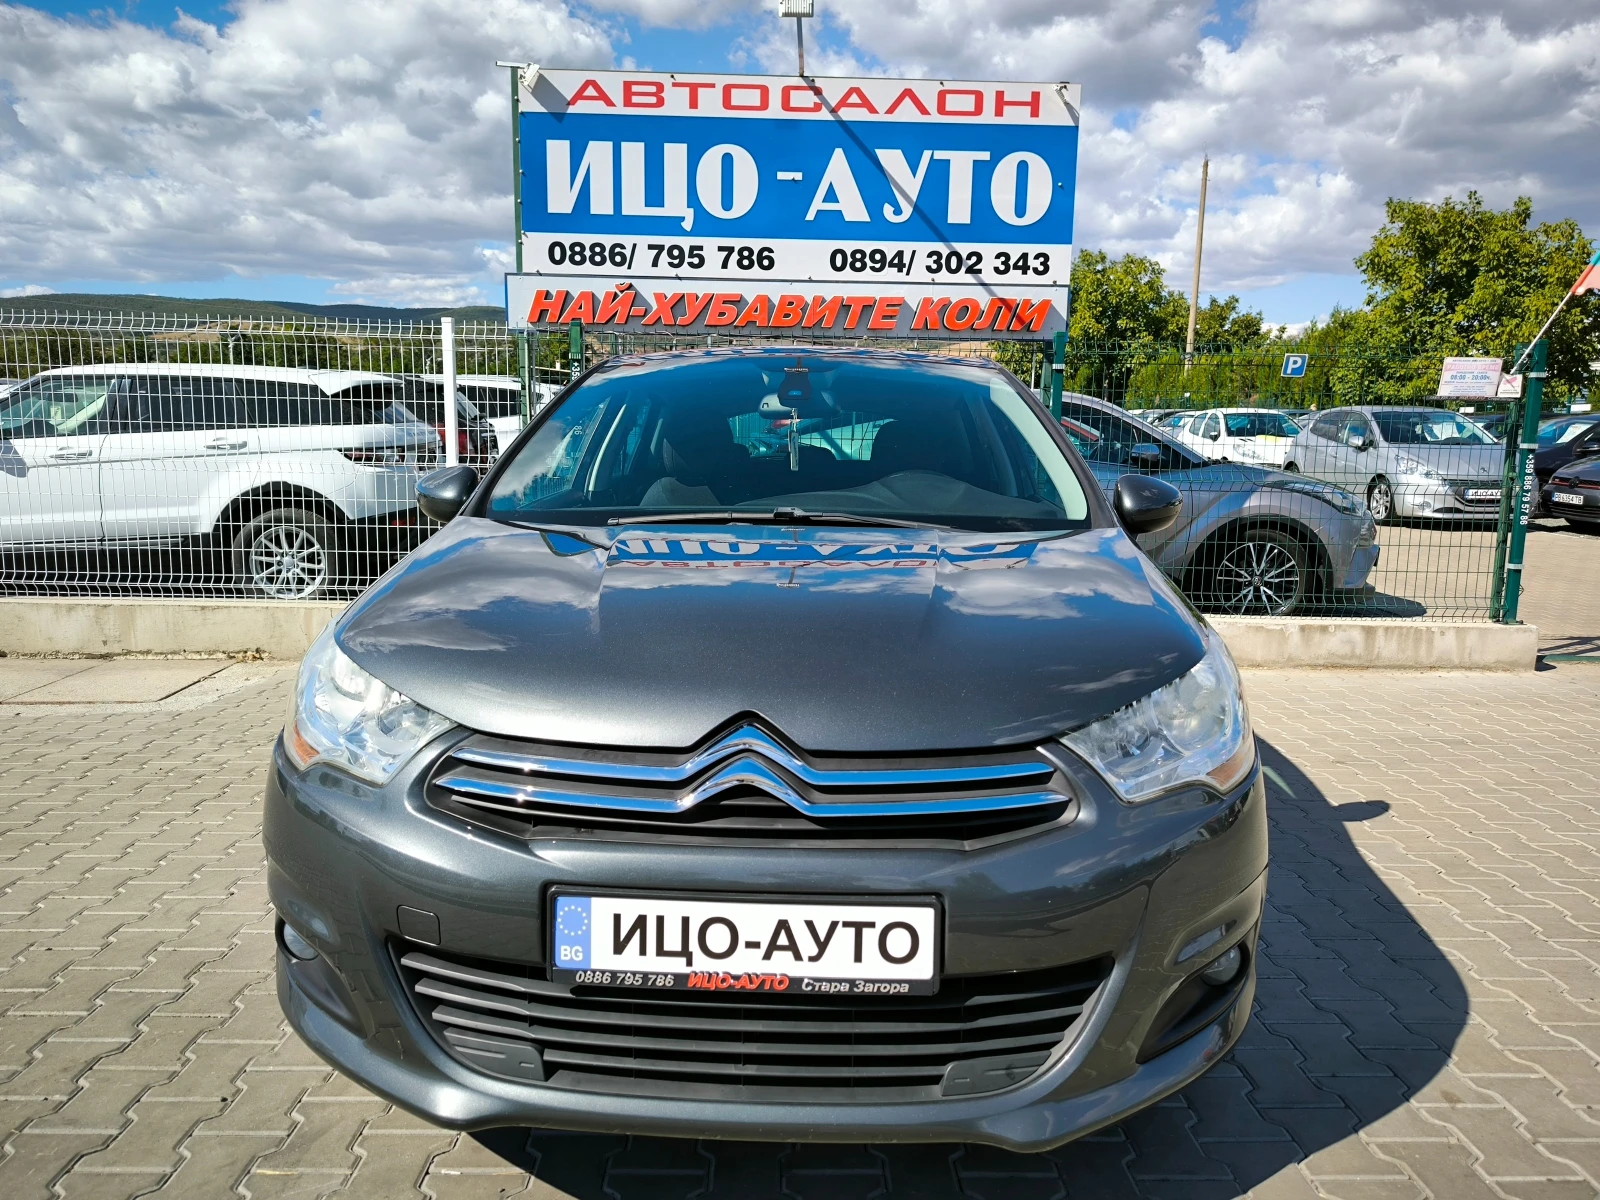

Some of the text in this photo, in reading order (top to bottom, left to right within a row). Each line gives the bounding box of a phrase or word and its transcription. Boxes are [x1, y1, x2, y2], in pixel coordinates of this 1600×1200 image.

[566, 79, 1041, 118] АВТОСАЛОН
[547, 242, 775, 271] 0886/ 795 786
[829, 248, 1051, 275] 0894/ 302 343
[527, 283, 1052, 332] НАЙ-ХУБАВИТЕ КОЛИ
[1286, 357, 1303, 373] P
[1519, 453, 1535, 525] +359 886 79 57 86
[560, 945, 583, 961] BG
[612, 912, 920, 967] ИЦО-АУТО
[576, 971, 909, 994] 0886 795 786 ИЦО-АУТО Стара Загора
